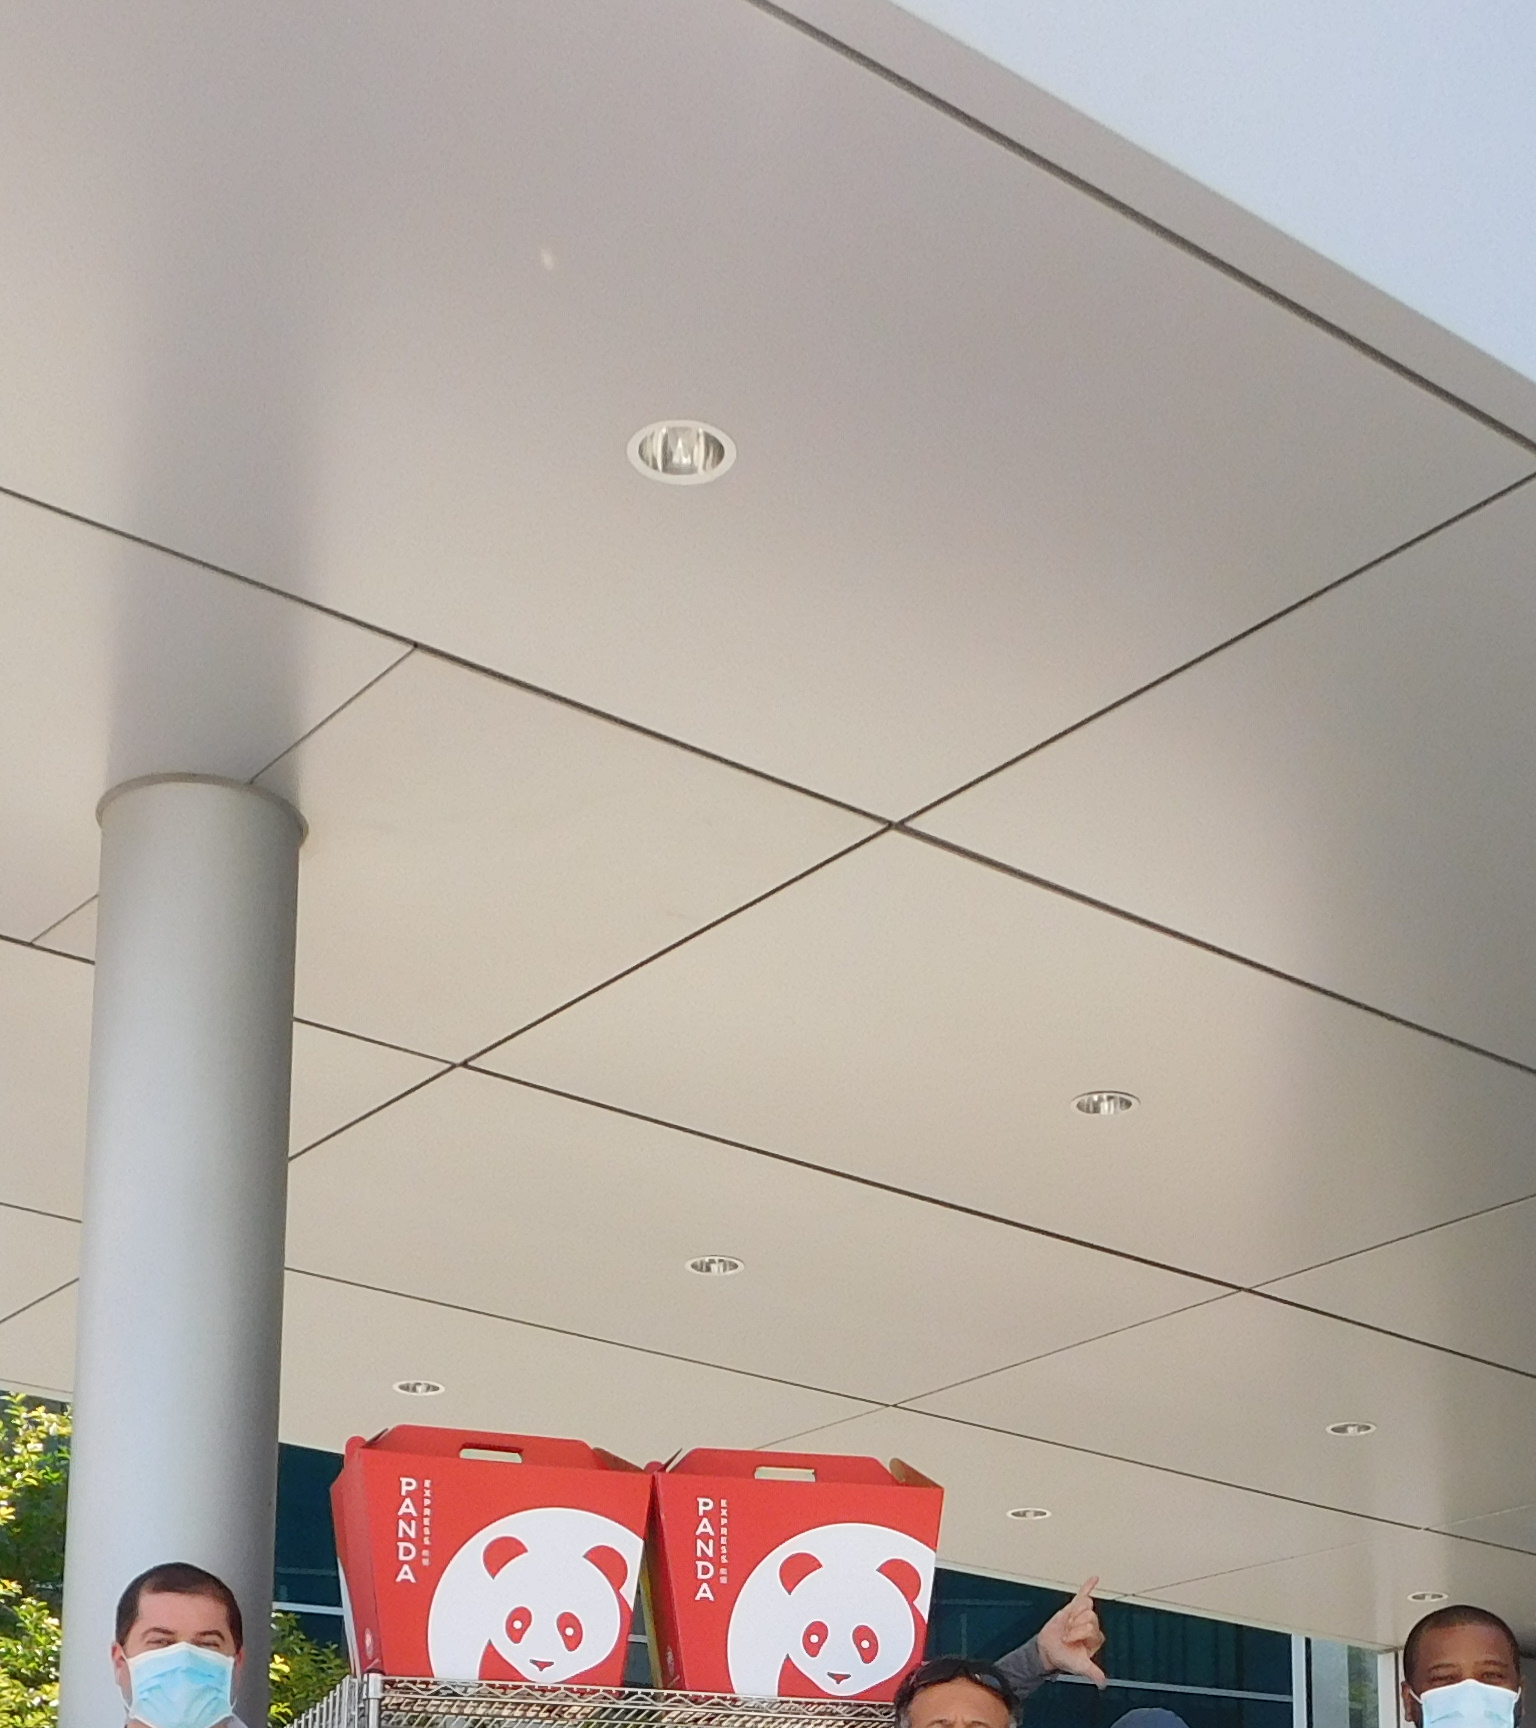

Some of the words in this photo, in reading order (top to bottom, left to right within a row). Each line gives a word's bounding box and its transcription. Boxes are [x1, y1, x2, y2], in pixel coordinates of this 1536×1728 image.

[396, 1477, 417, 1583] PANDA
[423, 1479, 432, 1545] EXPRESS
[694, 1497, 714, 1601] PANDA
[720, 1499, 728, 1563] EXPRESS
